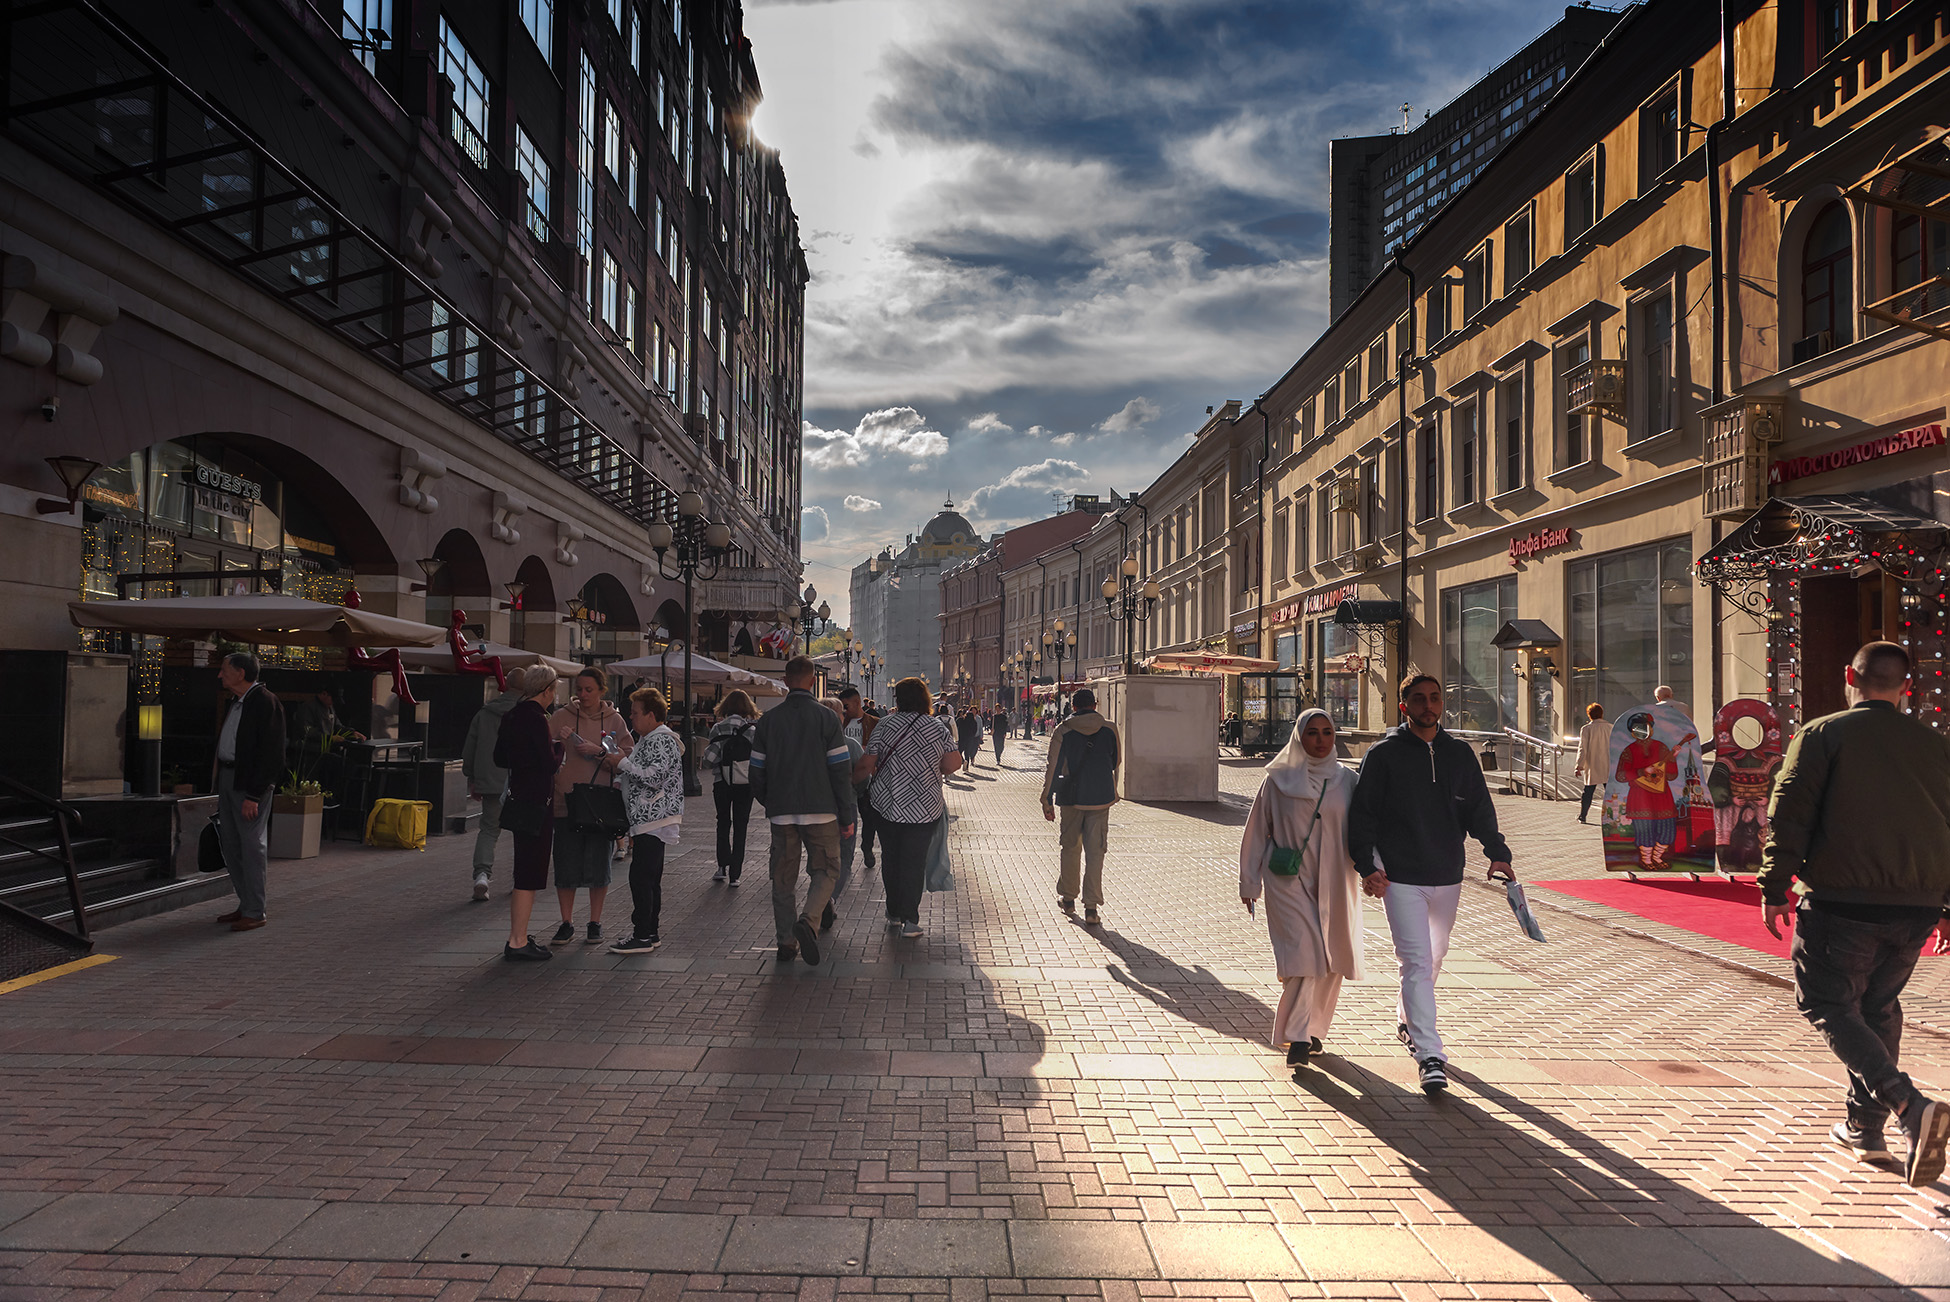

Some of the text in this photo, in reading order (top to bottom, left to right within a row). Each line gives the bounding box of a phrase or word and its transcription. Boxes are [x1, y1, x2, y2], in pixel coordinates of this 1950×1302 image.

[1787, 427, 1937, 481] МОСГОРЛОМБАРД
[196, 464, 262, 500] GUESTS
[212, 495, 229, 512] the
[232, 502, 251, 522] city
[1508, 528, 1569, 558] Альфа Банк
